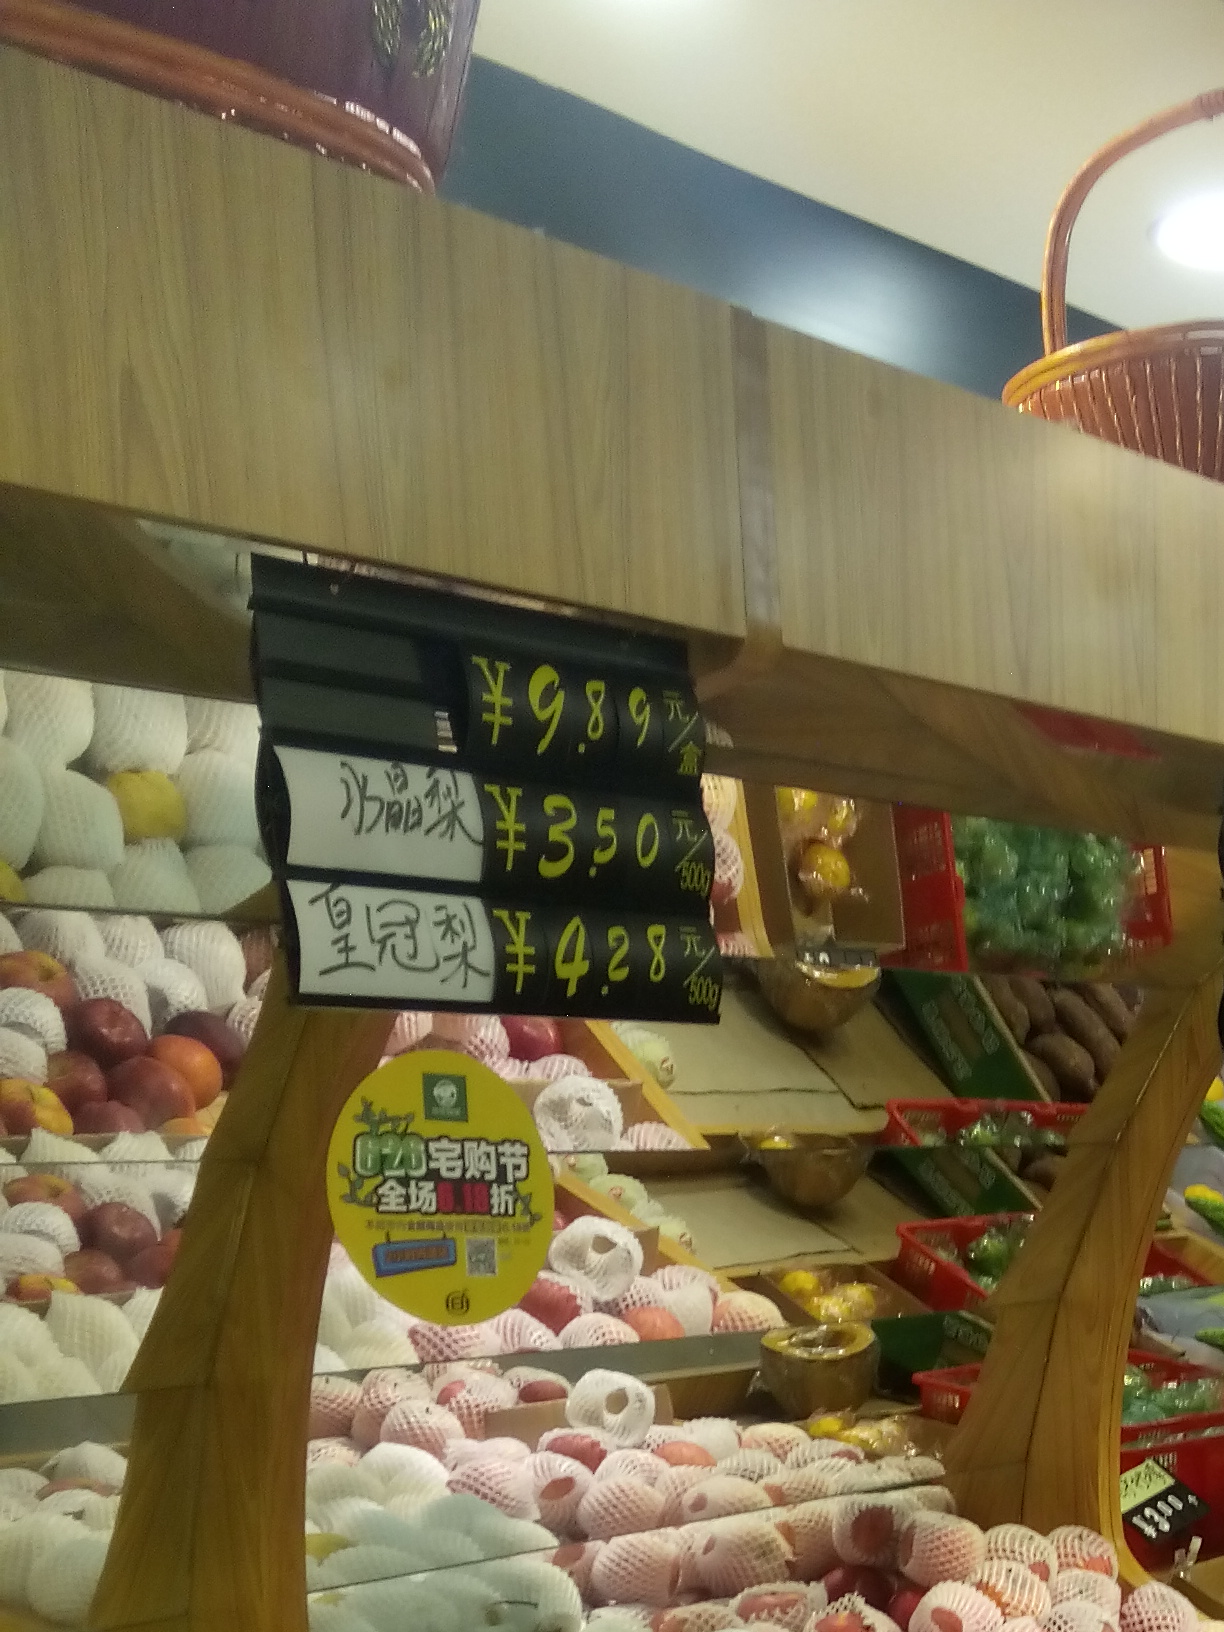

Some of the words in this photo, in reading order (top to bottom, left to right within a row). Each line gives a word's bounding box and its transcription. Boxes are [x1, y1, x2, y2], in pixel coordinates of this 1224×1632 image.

[472, 655, 652, 755] ¥9.89
[340, 761, 484, 847] 水晶梨
[485, 784, 660, 878] ¥3.50
[309, 882, 491, 988] 皇冠梨
[493, 909, 667, 997] ¥4.28
